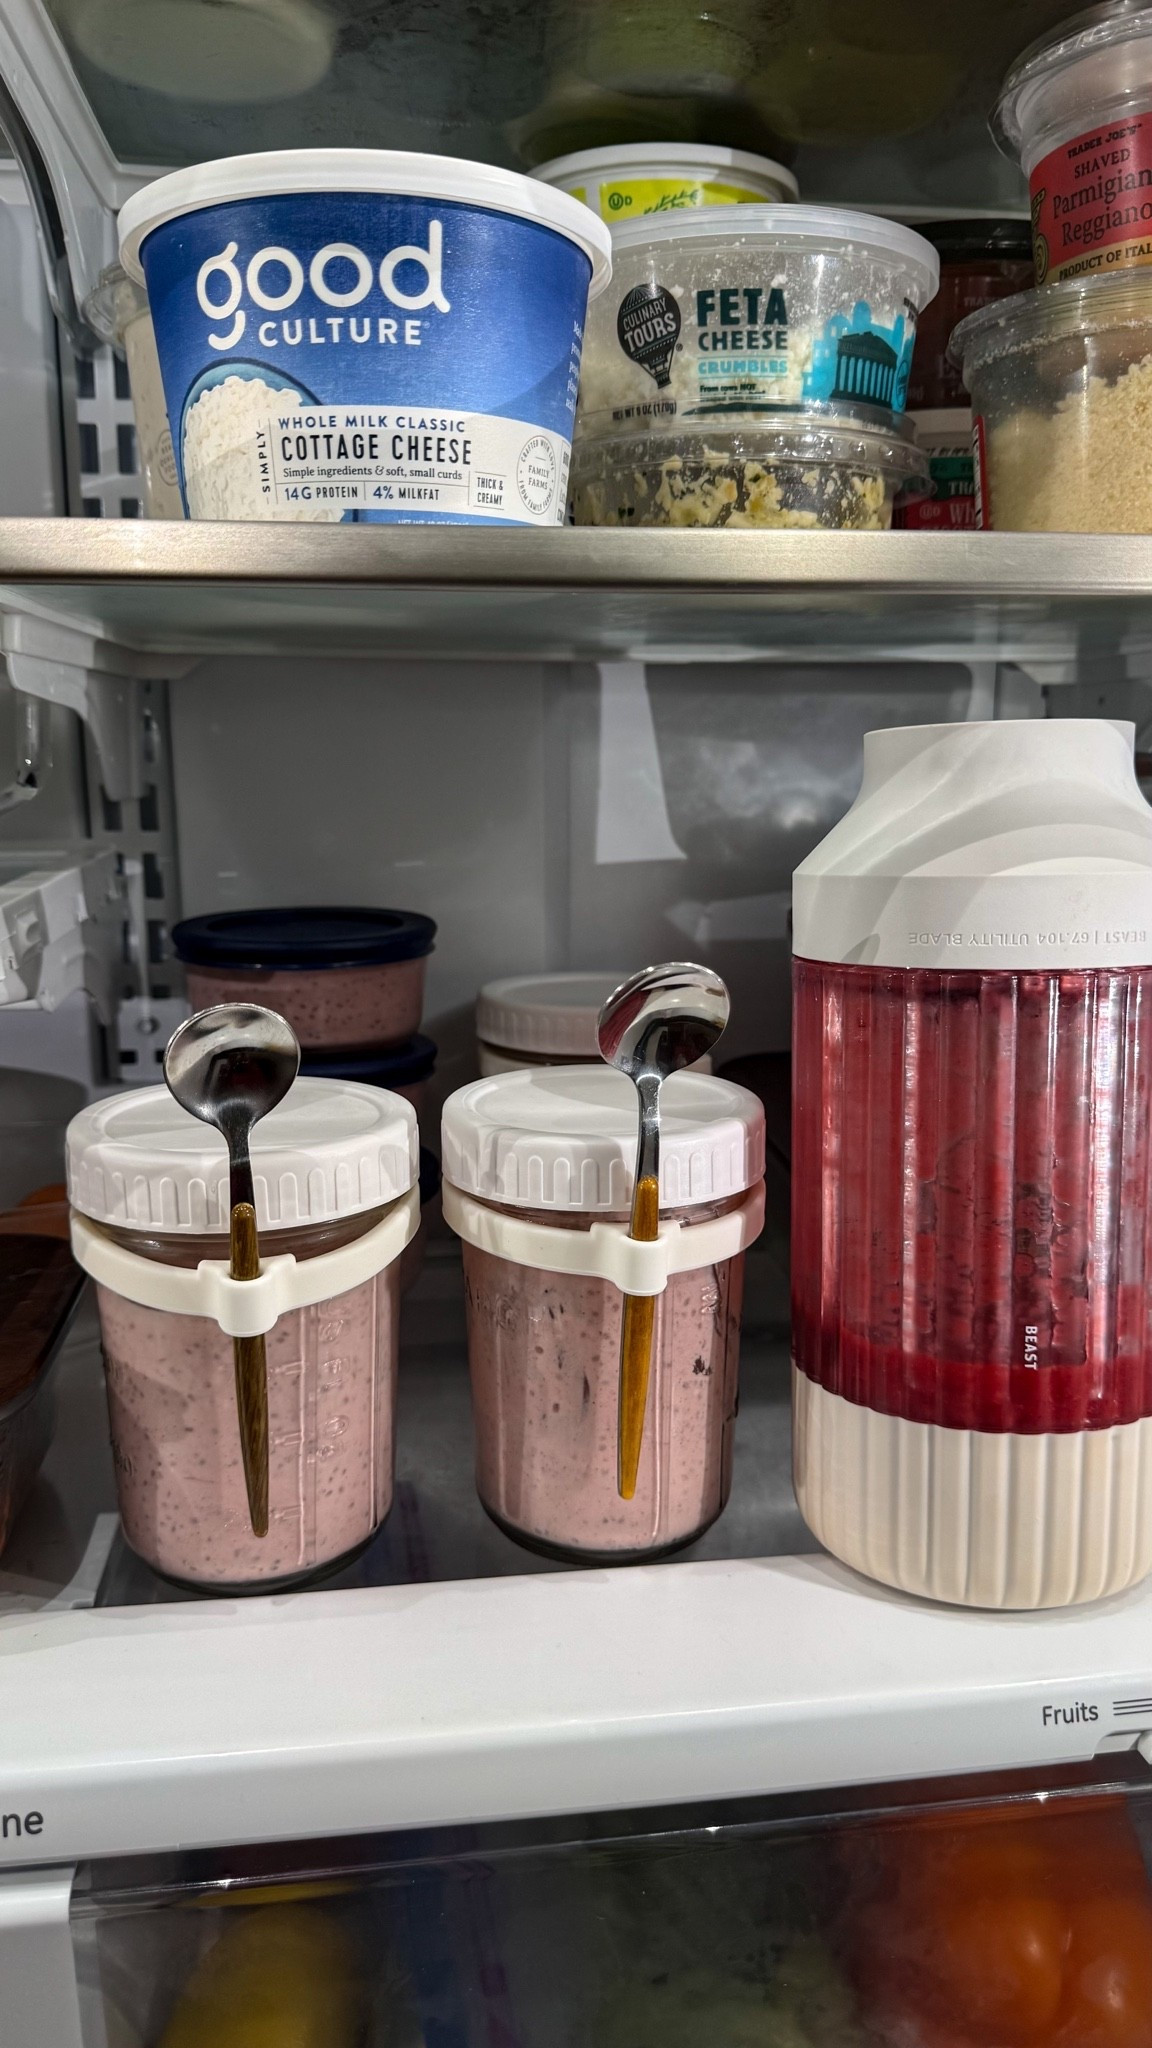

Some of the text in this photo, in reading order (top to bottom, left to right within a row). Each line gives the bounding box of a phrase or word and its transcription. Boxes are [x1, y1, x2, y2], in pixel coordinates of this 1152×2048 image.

[1067, 136, 1102, 159] TRADER
[1074, 148, 1130, 179] SHAVED
[1062, 201, 1152, 247] Reggiano
[1059, 254, 1103, 281] PRODUCT
[1106, 249, 1121, 264] OF
[197, 219, 451, 350] good
[623, 297, 667, 331] CULINARY
[697, 287, 788, 327] FETA
[258, 317, 422, 347] CULTURE
[624, 312, 677, 353] TOURS
[698, 330, 788, 352] CHEESE
[698, 358, 788, 375] CRUMBLES
[700, 385, 719, 393] From
[740, 383, 756, 391] NOT
[642, 403, 652, 415] OZ
[653, 400, 677, 417] (170g)
[278, 415, 466, 433] WHOLE MILK CLASSIC
[281, 434, 472, 465] COTTAGE CHEESE
[520, 439, 539, 463] CRAFTED
[256, 431, 271, 493] SIMPLY
[528, 464, 550, 479] FAMILY
[283, 465, 463, 480] Simple ingredients & soft, small curds
[284, 486, 358, 500] 14G PROTEIN
[373, 486, 440, 501] 4% MILKFAT
[477, 476, 504, 491] THICK &
[528, 477, 548, 490] FARMS
[477, 492, 503, 506] CREAMY
[908, 932, 963, 946] BLADE
[969, 933, 1029, 947] UTILITY
[1037, 931, 1089, 945] 67.104
[1103, 930, 1147, 945] BEAST
[1024, 1325, 1038, 1371] BEAST
[1042, 1701, 1099, 1726] Fruits
